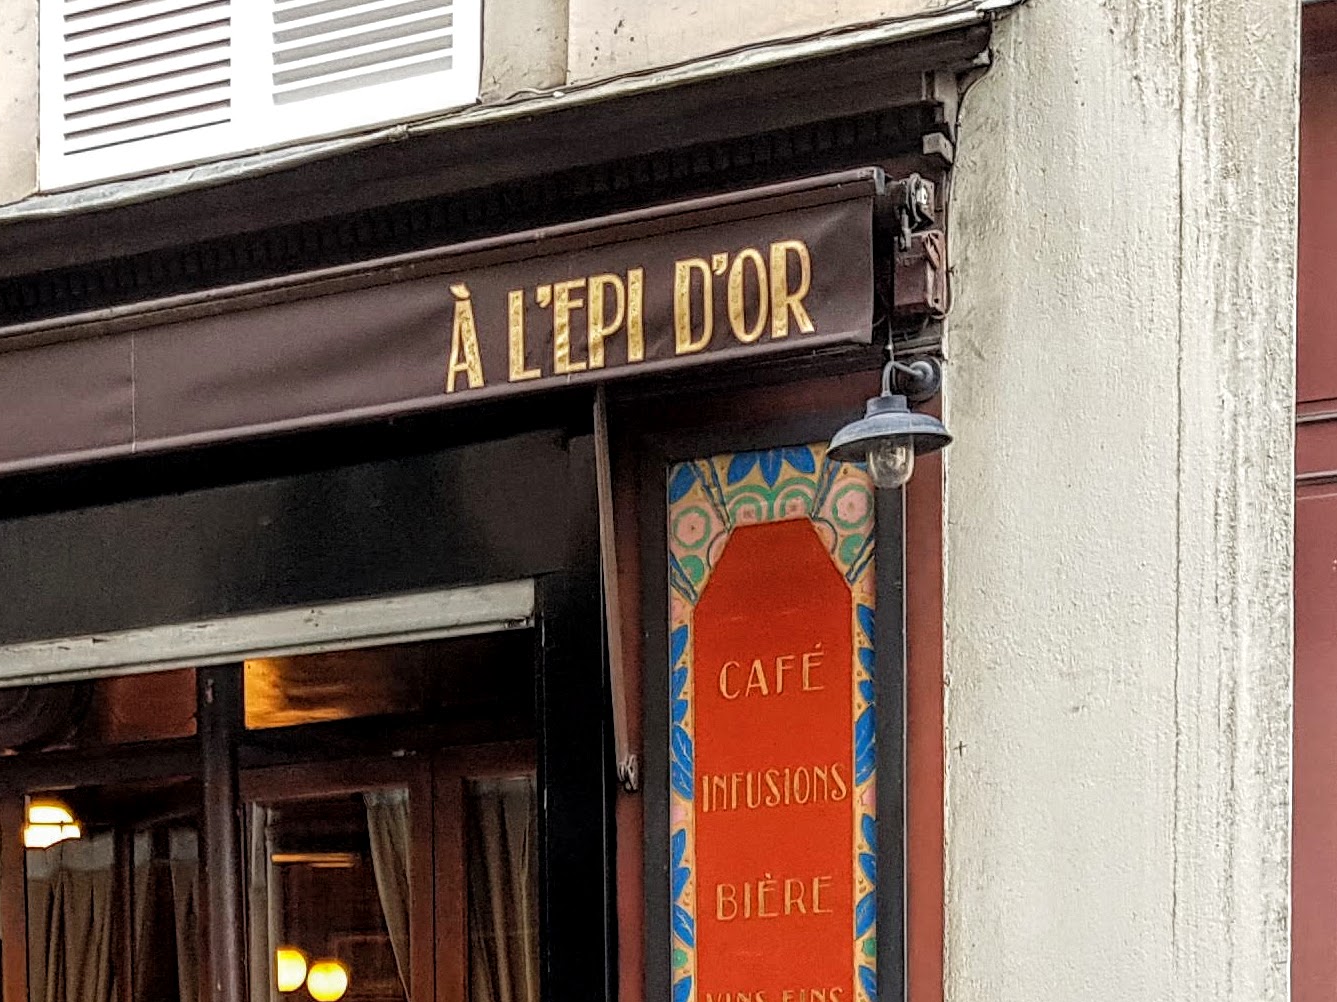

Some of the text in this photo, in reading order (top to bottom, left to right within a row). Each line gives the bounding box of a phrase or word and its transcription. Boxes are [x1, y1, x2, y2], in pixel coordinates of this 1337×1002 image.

[445, 239, 815, 394] À L'EPI D'OR
[719, 642, 825, 700] CAFÉ
[701, 762, 847, 813] INFUSIONS
[716, 873, 833, 922] BIÈRE
